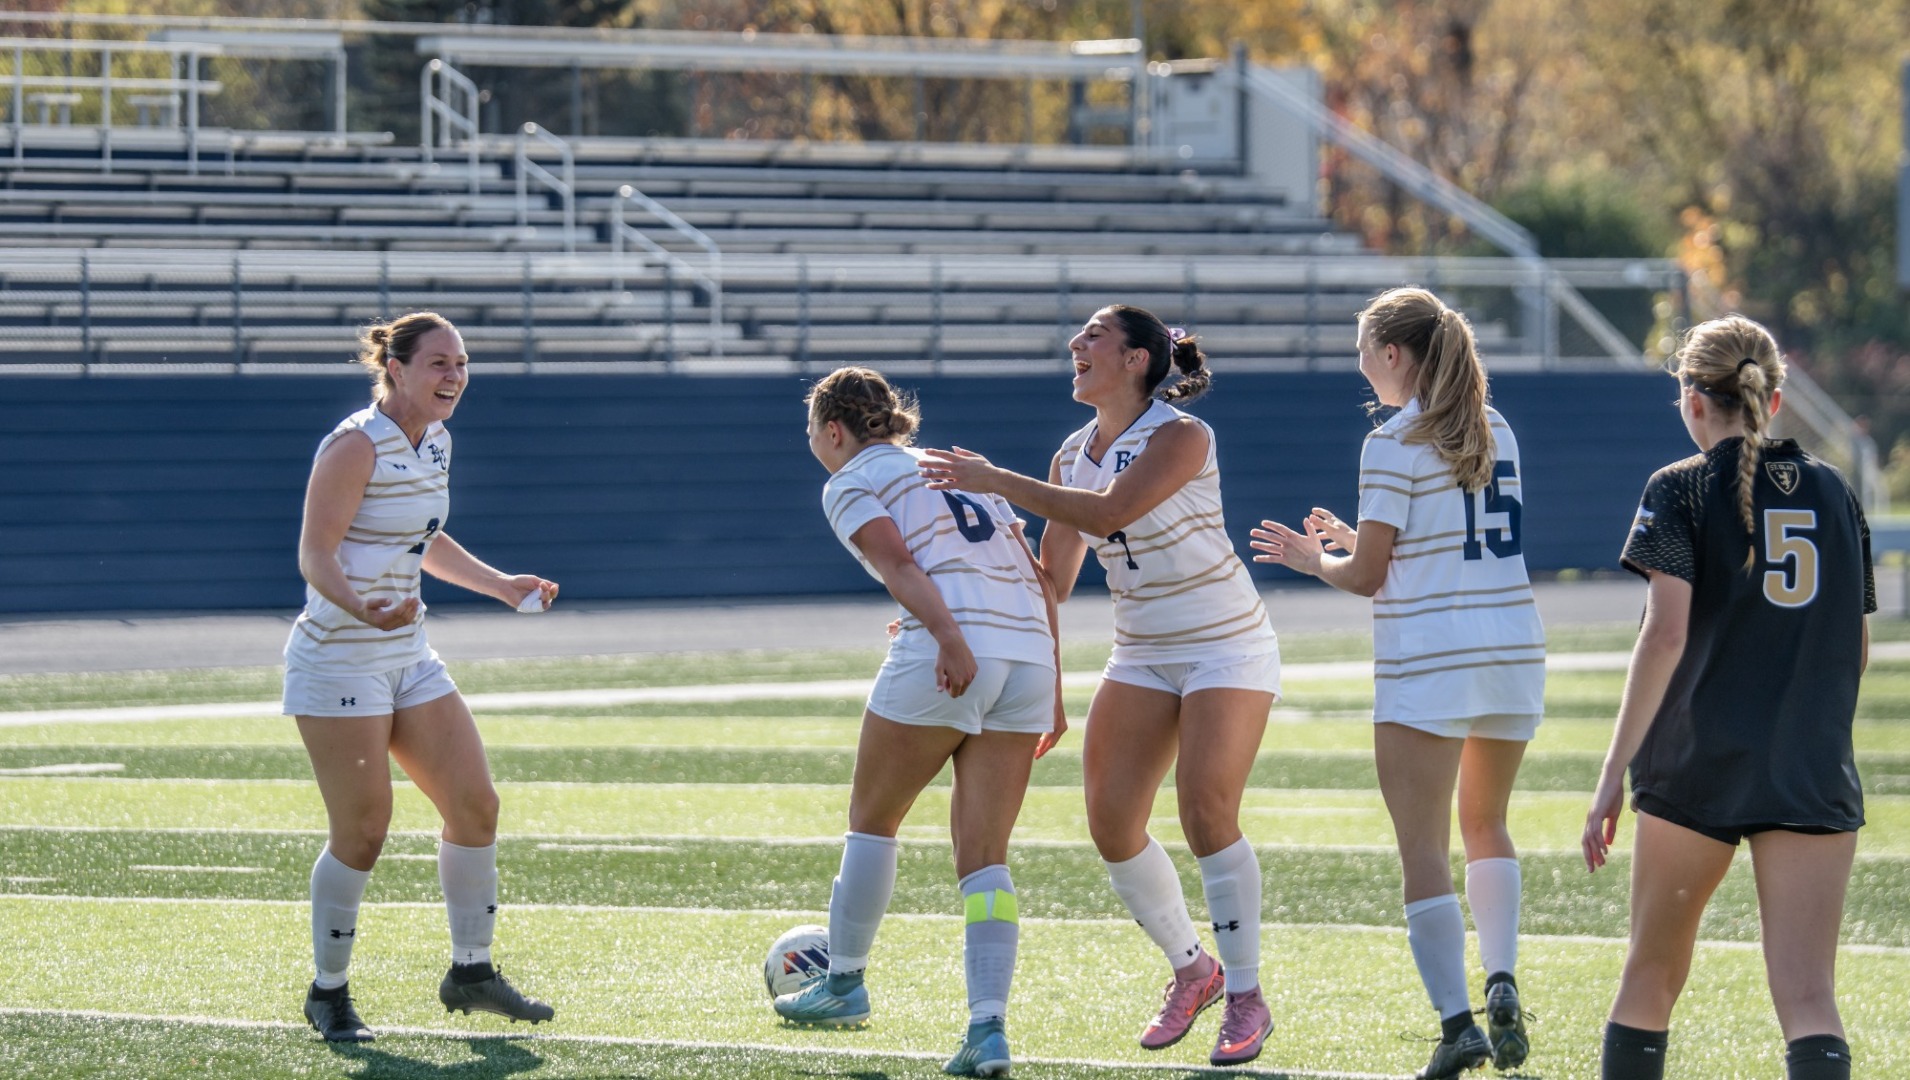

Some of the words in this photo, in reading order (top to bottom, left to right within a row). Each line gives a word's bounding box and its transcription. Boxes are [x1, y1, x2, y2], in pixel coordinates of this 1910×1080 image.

[407, 517, 440, 555] 2
[1457, 460, 1522, 561] 15
[1763, 508, 1818, 607] 5
